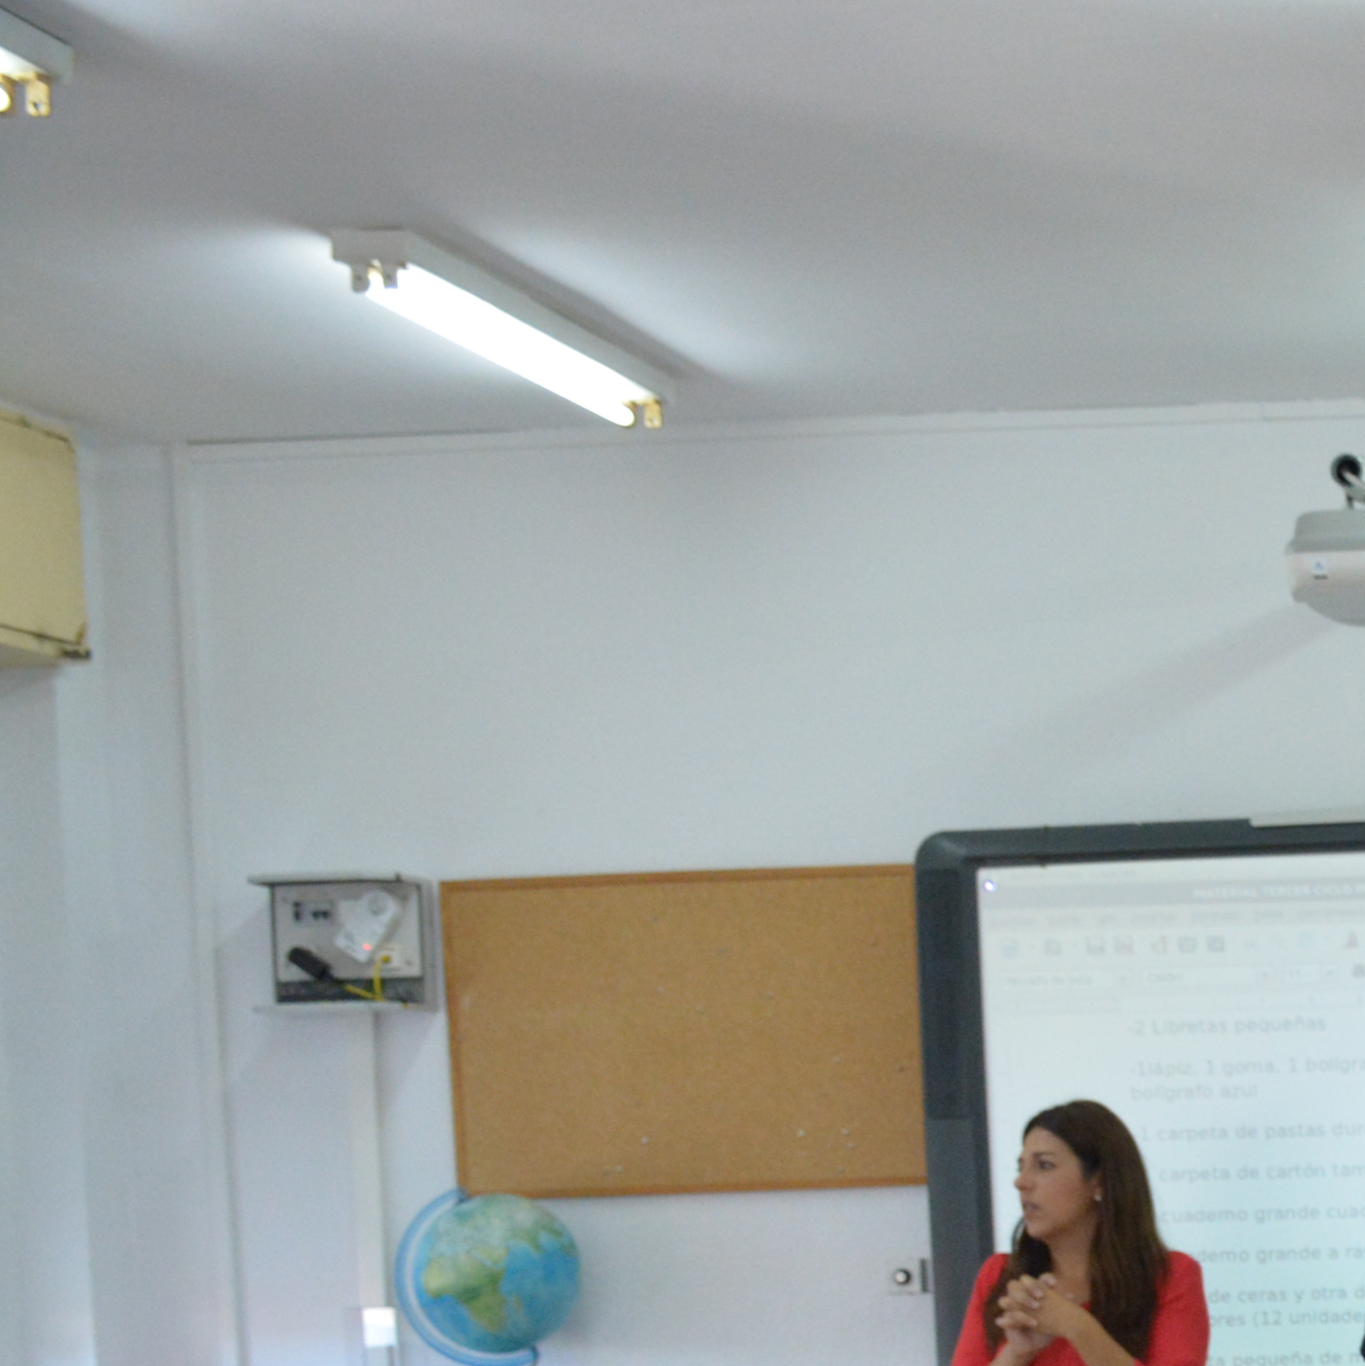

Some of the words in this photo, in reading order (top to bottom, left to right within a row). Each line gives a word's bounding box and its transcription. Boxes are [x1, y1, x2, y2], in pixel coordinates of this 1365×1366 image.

[1151, 1017, 1228, 1036] Libretas
[1234, 1013, 1327, 1037] pequeñas
[1219, 1083, 1260, 1099] azul
[1156, 1126, 1229, 1144] carpeta
[1235, 1123, 1258, 1140] de
[1264, 1123, 1326, 1141] pastas
[1157, 1165, 1231, 1185] carpeta
[1236, 1164, 1260, 1181] de
[1265, 1162, 1325, 1180] cartón
[1254, 1204, 1321, 1225] grande
[1255, 1245, 1321, 1266] grande
[1237, 1287, 1287, 1303] ceras
[1293, 1288, 1304, 1305] y
[1311, 1286, 1348, 1301] otra
[1252, 1310, 1282, 1328] (12
[1319, 1349, 1343, 1366] de
